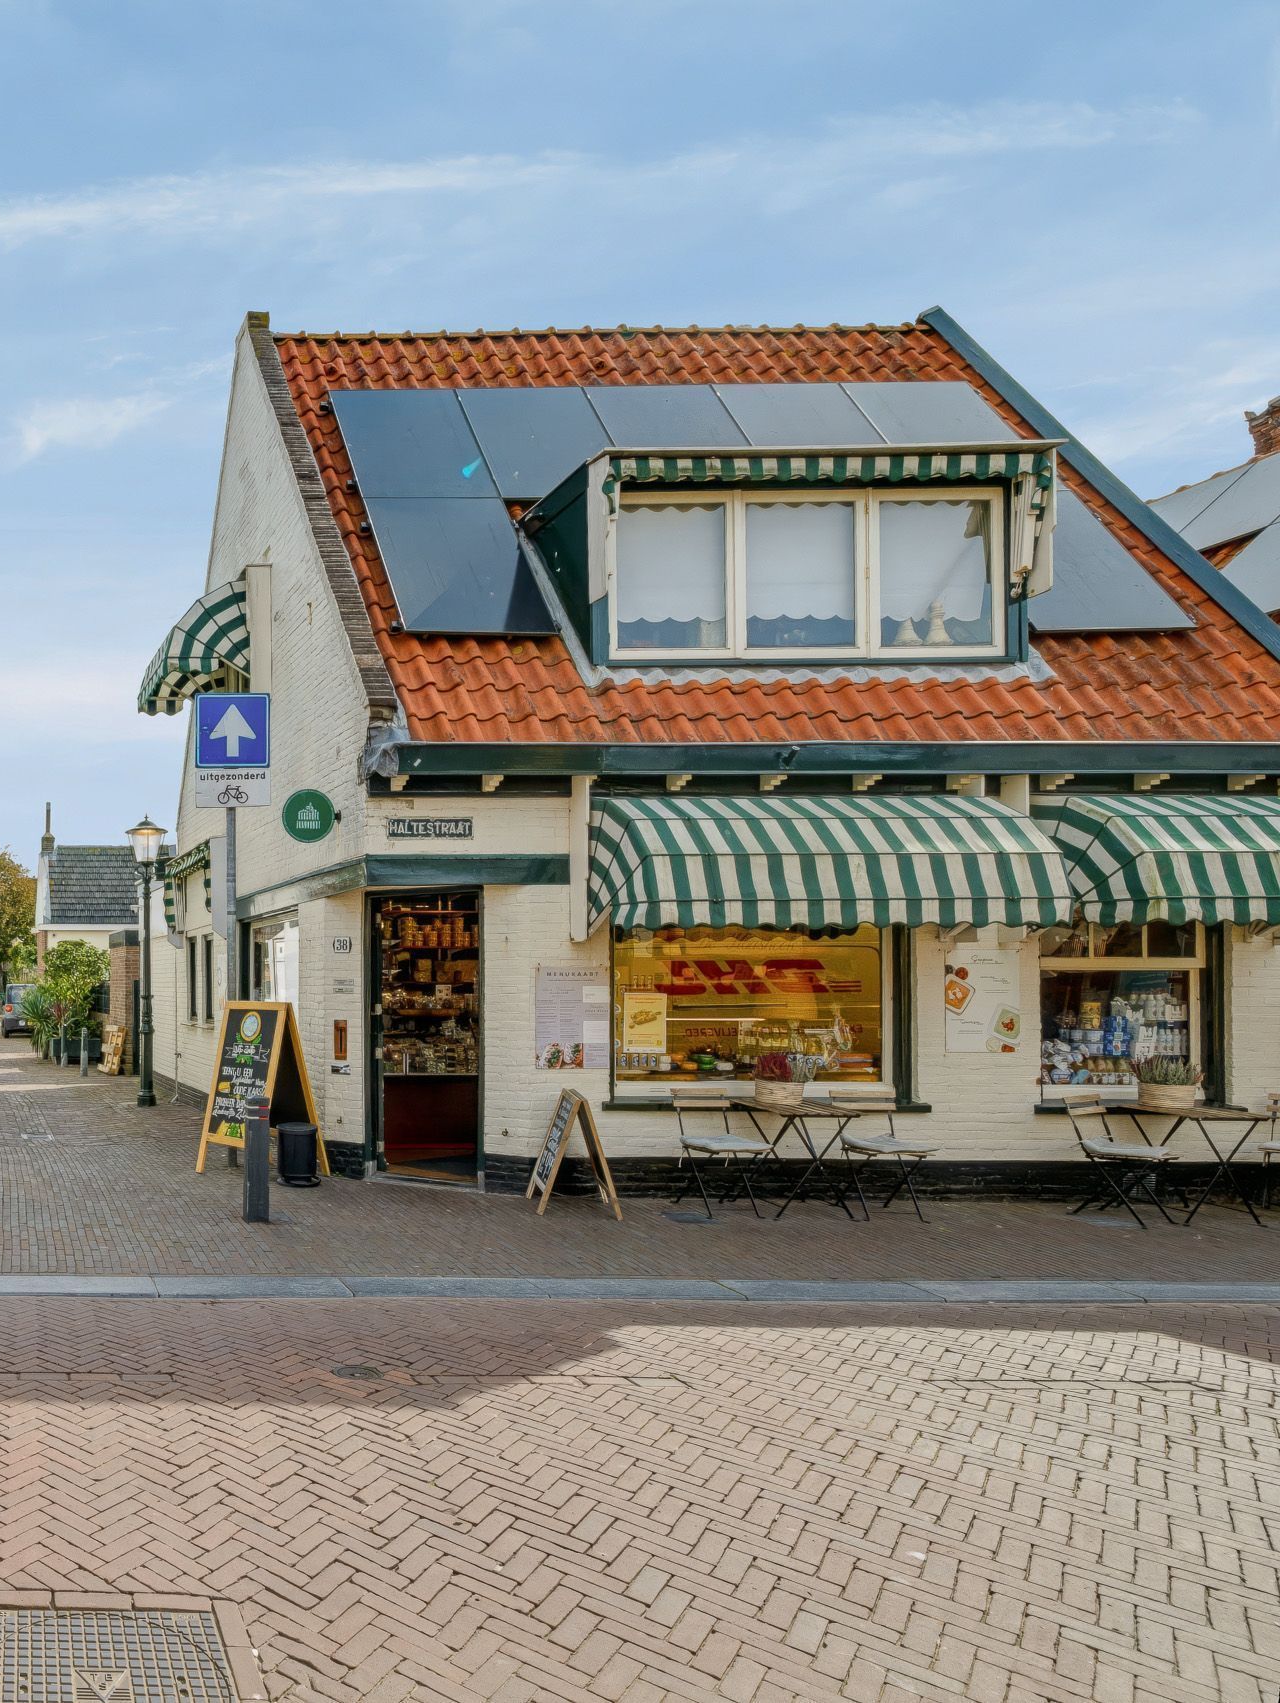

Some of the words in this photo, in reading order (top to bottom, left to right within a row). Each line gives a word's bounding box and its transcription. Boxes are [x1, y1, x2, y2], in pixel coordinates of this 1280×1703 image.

[199, 771, 266, 783] uitgezonderd
[389, 821, 470, 835] HALTESTRAAT
[336, 938, 348, 951] 38
